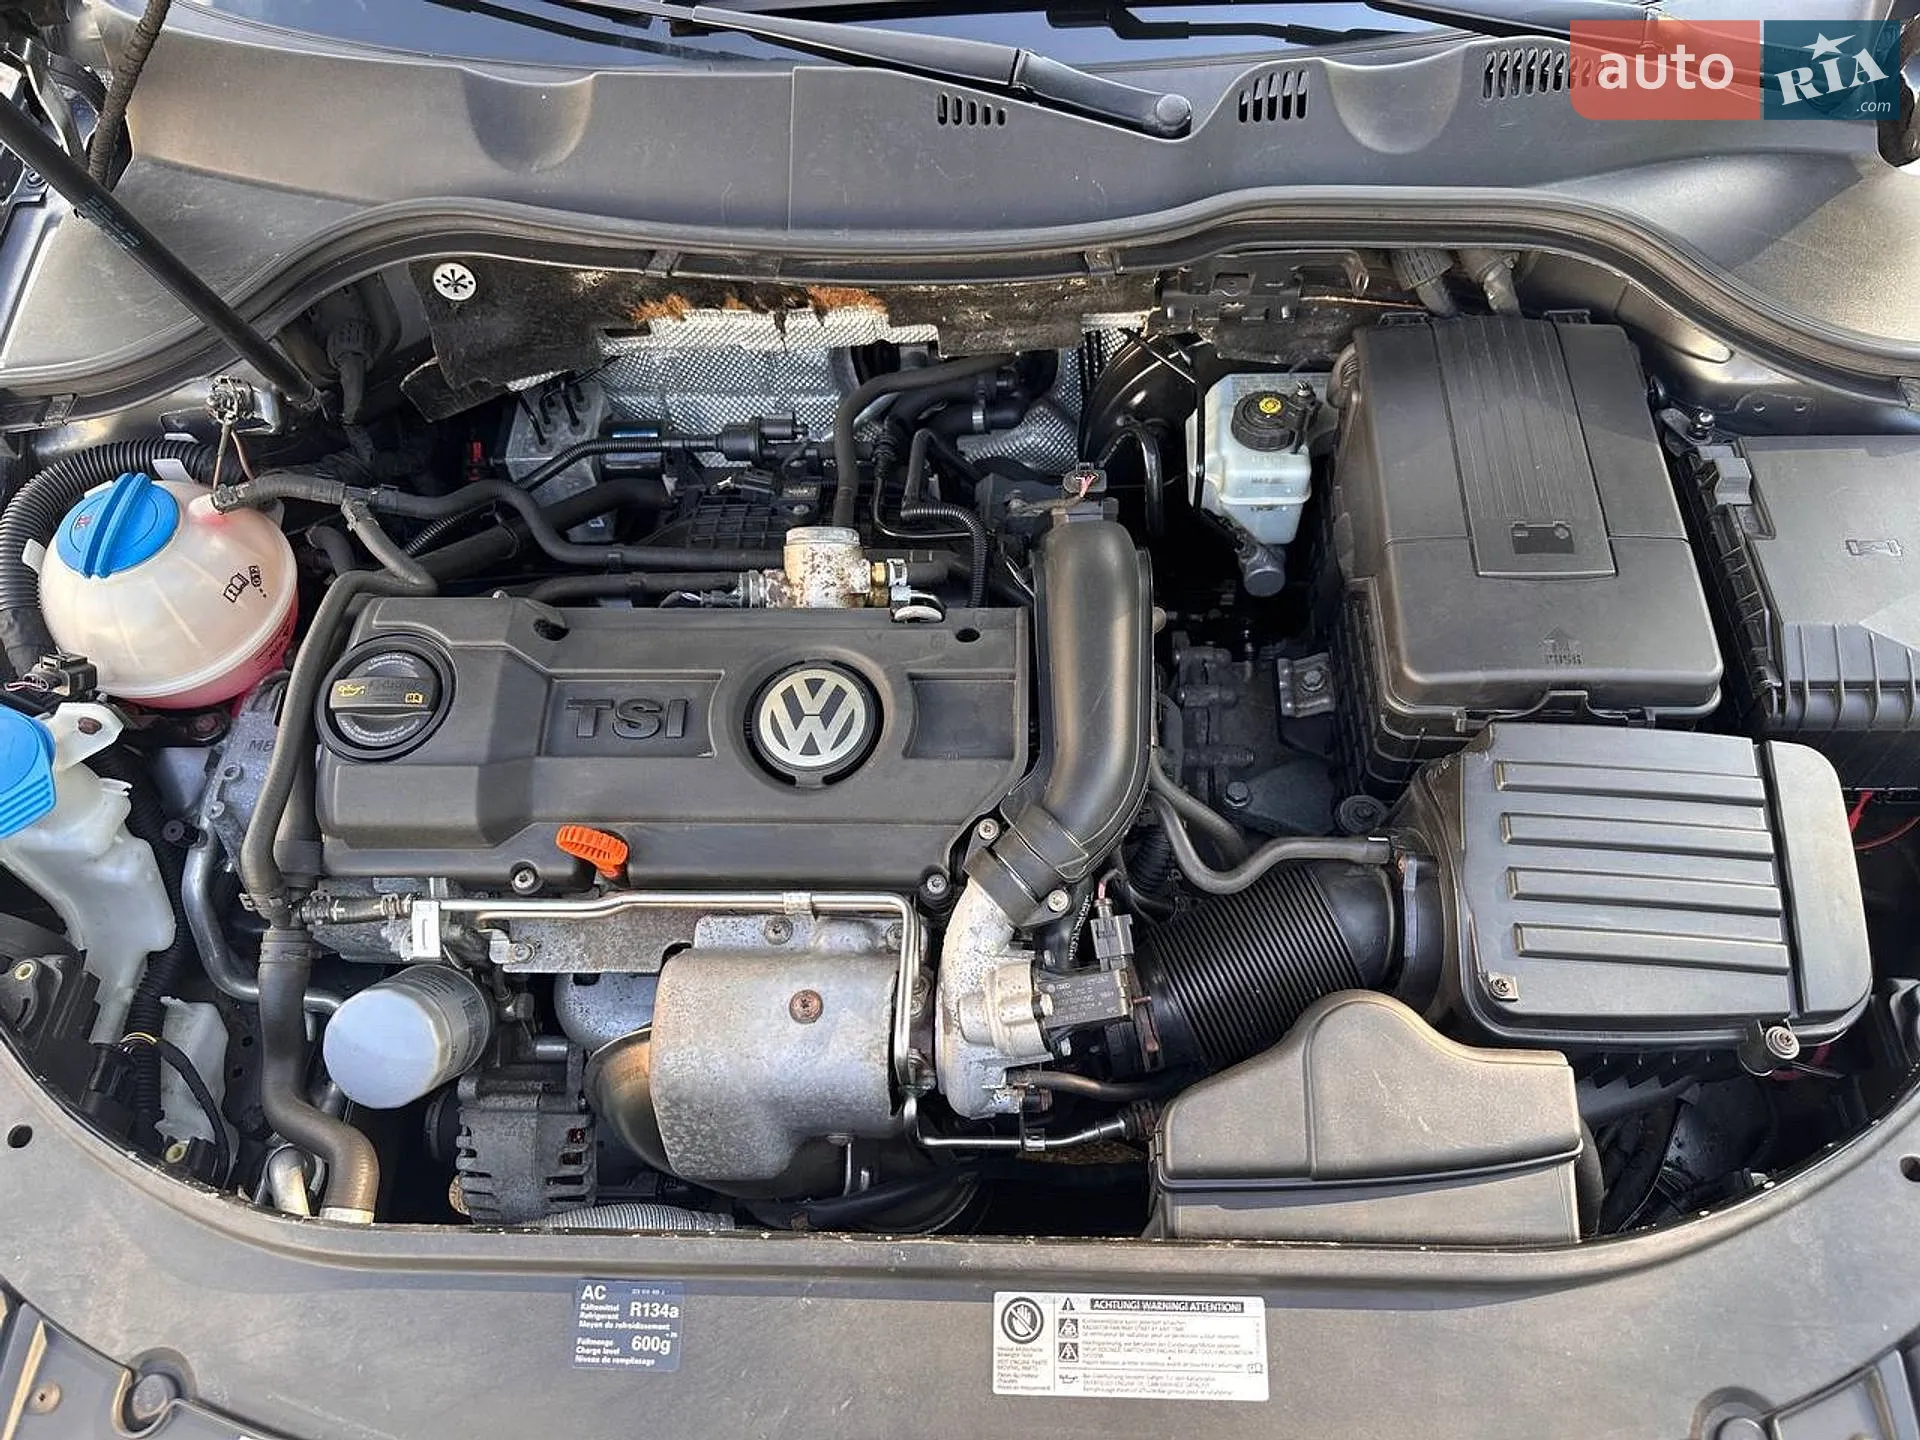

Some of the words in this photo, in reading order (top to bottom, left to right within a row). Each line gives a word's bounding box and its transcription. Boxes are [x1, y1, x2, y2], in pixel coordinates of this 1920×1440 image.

[565, 698, 689, 740] TSI
[581, 1285, 607, 1301] AC
[630, 1301, 680, 1319] R134a
[1093, 1300, 1140, 1310] ACHTUNG!
[1142, 1301, 1188, 1311] WARNING!
[1189, 1302, 1242, 1313] ATTENTION!
[631, 1335, 672, 1356] 600g
